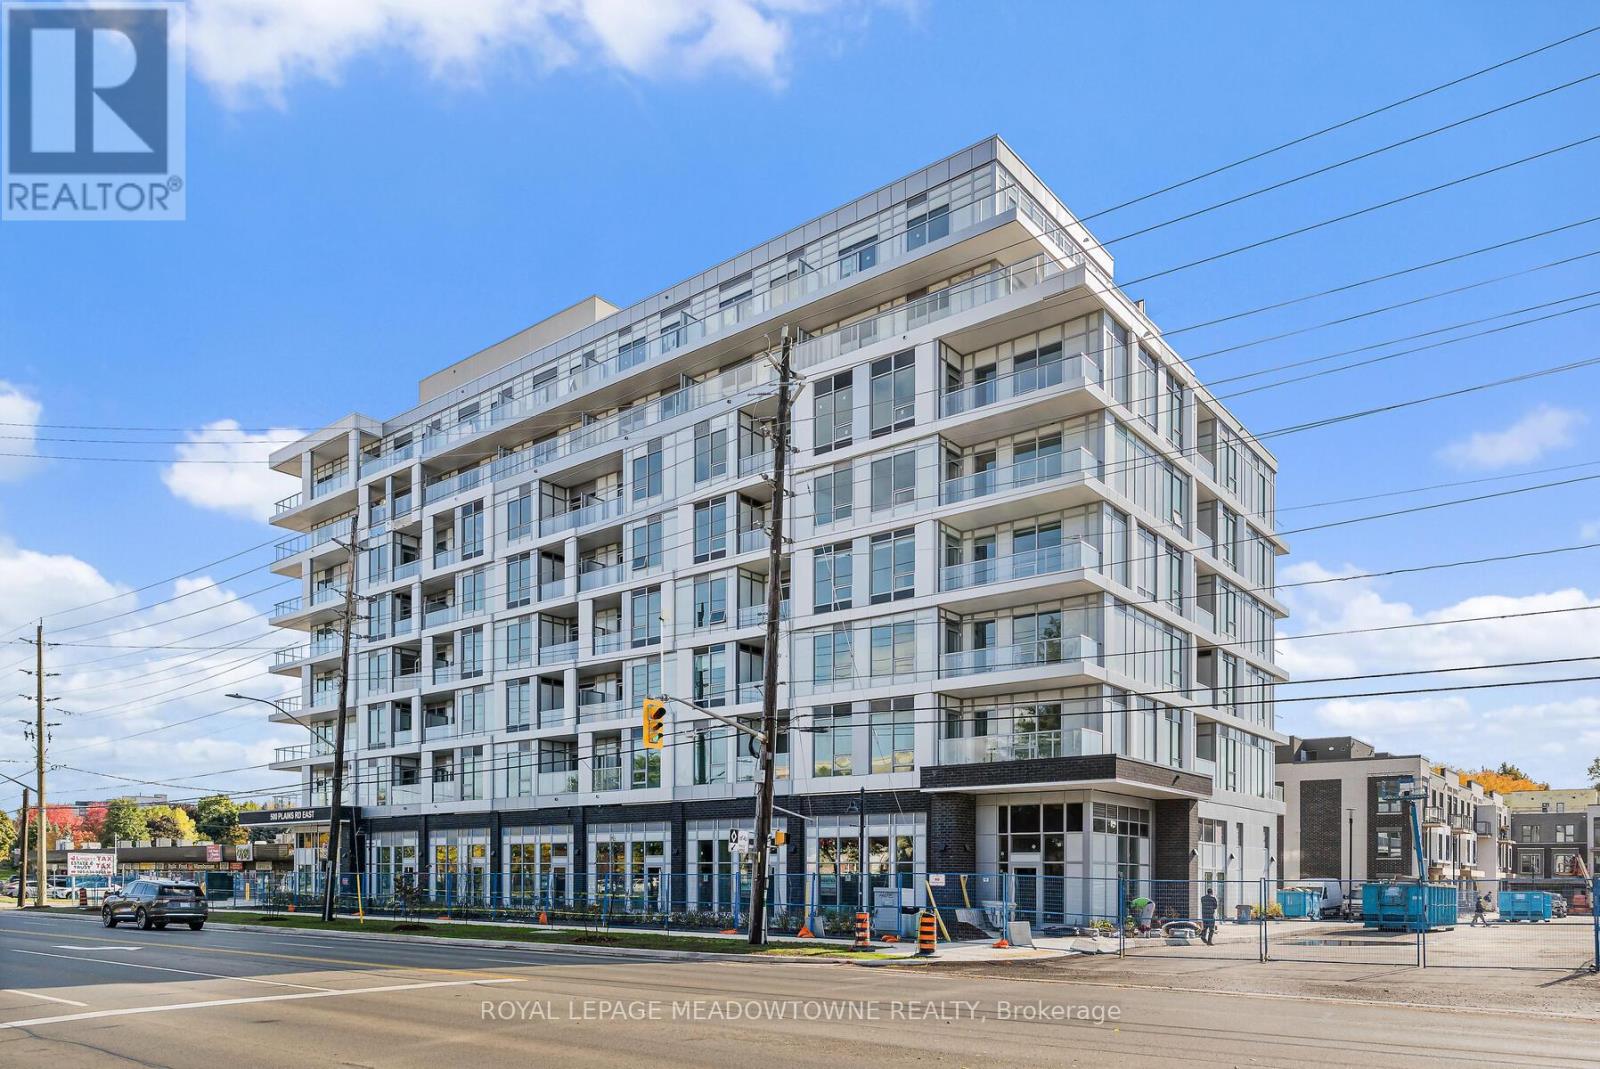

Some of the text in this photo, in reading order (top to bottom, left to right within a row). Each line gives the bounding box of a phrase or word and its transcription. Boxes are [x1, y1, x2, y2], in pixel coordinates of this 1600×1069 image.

[278, 812, 294, 820] PLAINS
[295, 811, 301, 819] RD
[302, 810, 314, 818] EAST
